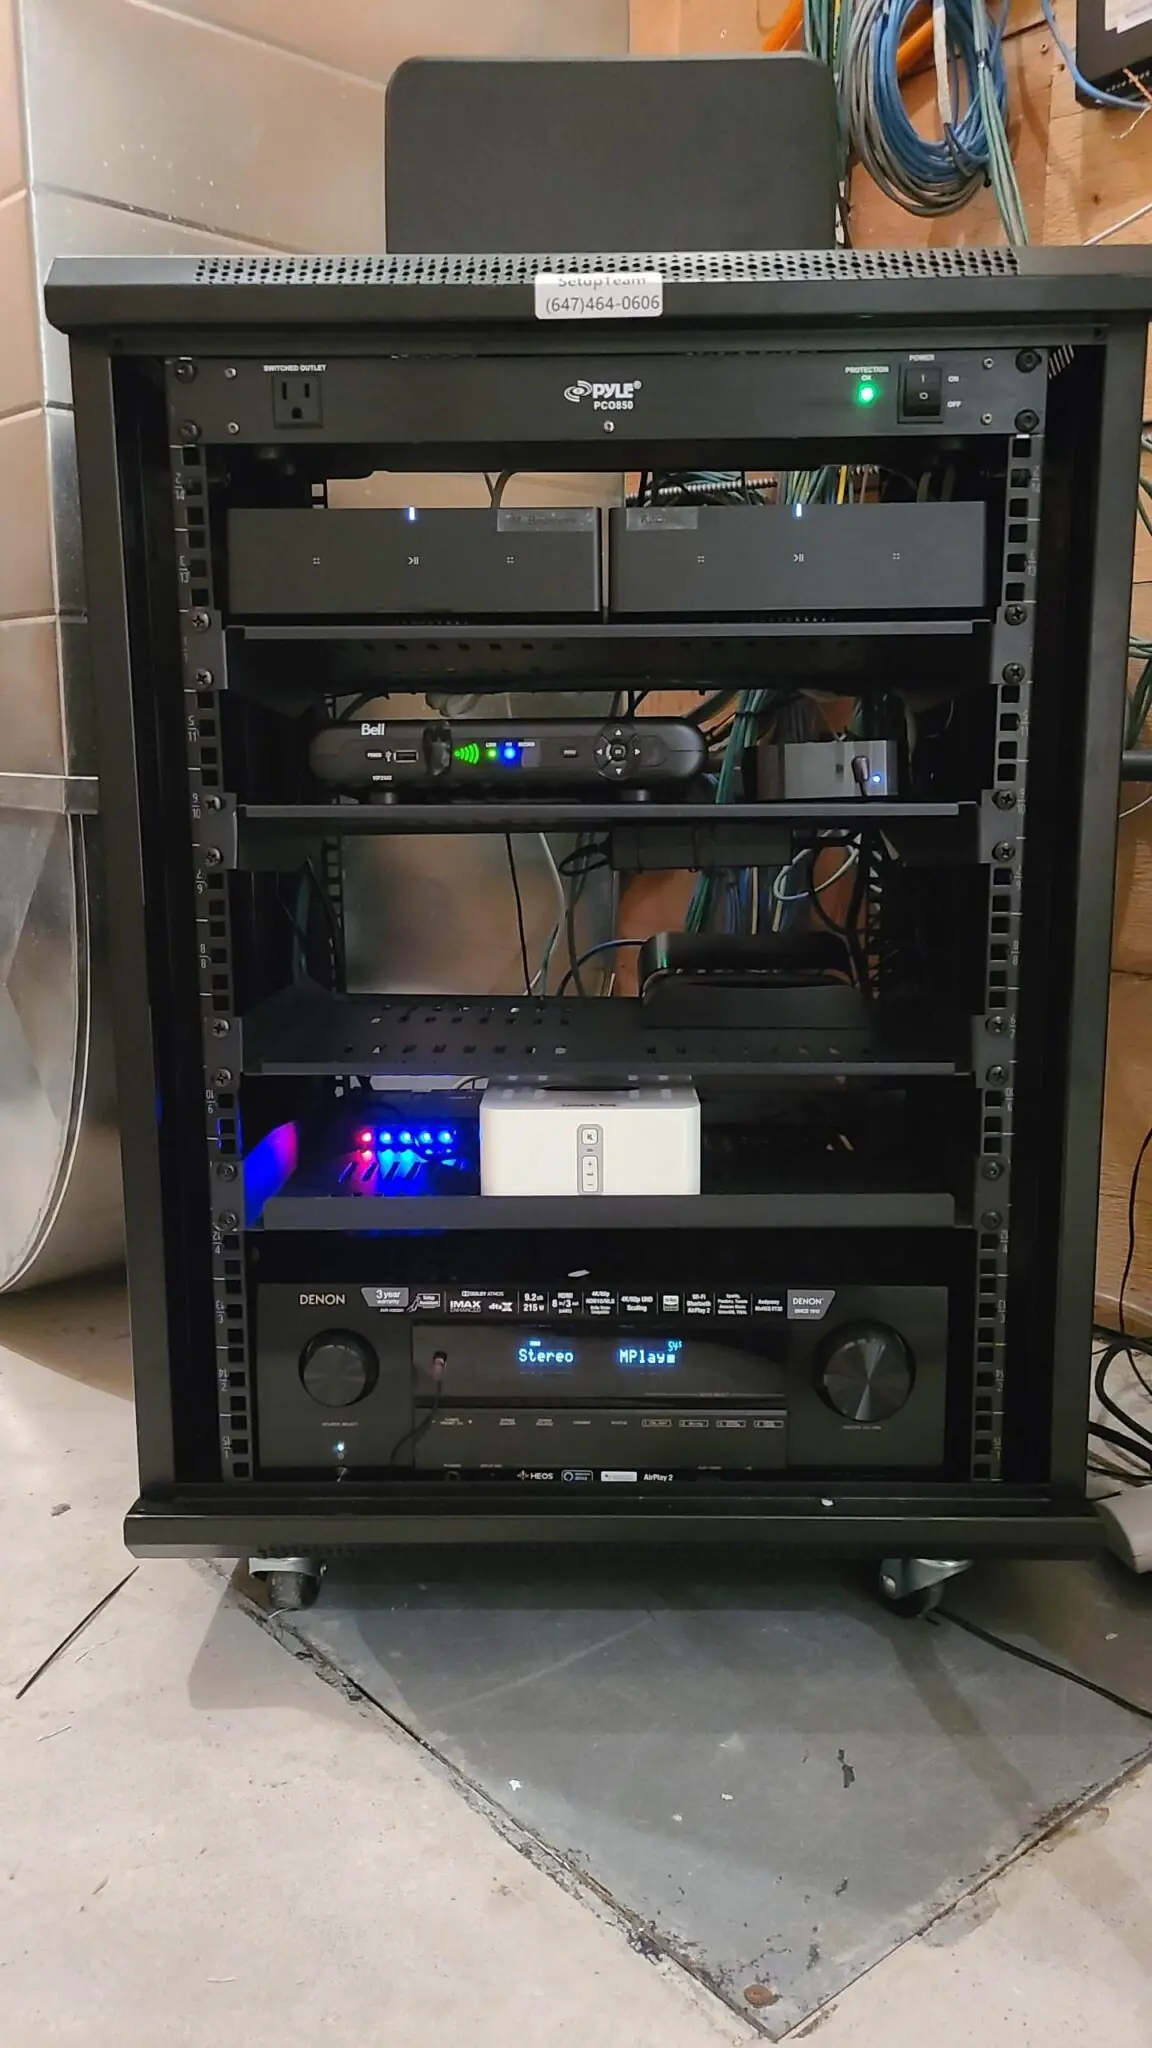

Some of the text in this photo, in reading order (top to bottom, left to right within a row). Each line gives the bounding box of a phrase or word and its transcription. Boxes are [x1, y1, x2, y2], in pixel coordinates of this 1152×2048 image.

[546, 295, 660, 314] (647)464-0606
[592, 383, 634, 399] PYLE
[594, 400, 634, 410] PCO850
[361, 723, 385, 736] Bell
[299, 1293, 346, 1305] DENON
[375, 1289, 401, 1299] 3 year
[450, 1300, 482, 1308] IMAX
[792, 1297, 823, 1306] DENON
[523, 1303, 538, 1312] 215
[518, 1348, 574, 1363] Stereo
[619, 1349, 665, 1364] MPlay
[530, 1472, 554, 1480] HEOS
[643, 1473, 668, 1482] AirPlay
